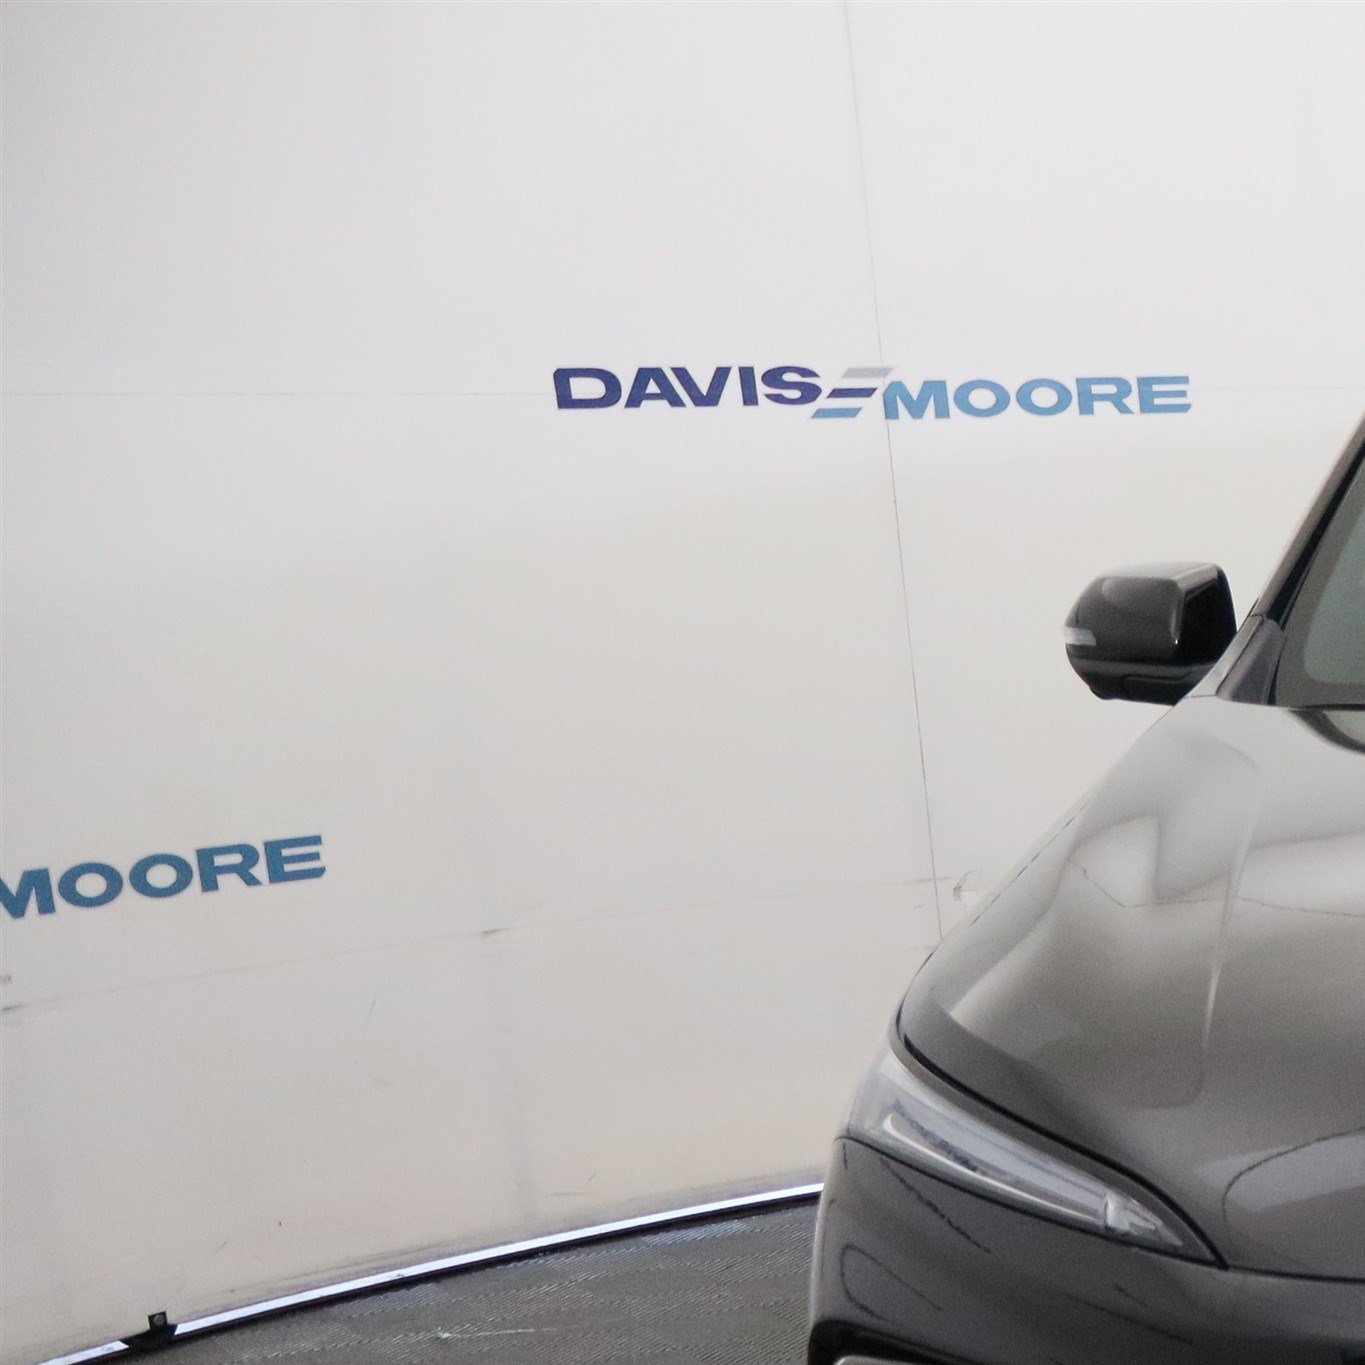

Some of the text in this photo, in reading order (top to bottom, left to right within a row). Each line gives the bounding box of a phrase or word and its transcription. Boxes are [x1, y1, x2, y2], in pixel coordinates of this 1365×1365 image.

[553, 366, 1192, 419] DAVIS MOORE
[0, 835, 327, 919] MOORE
